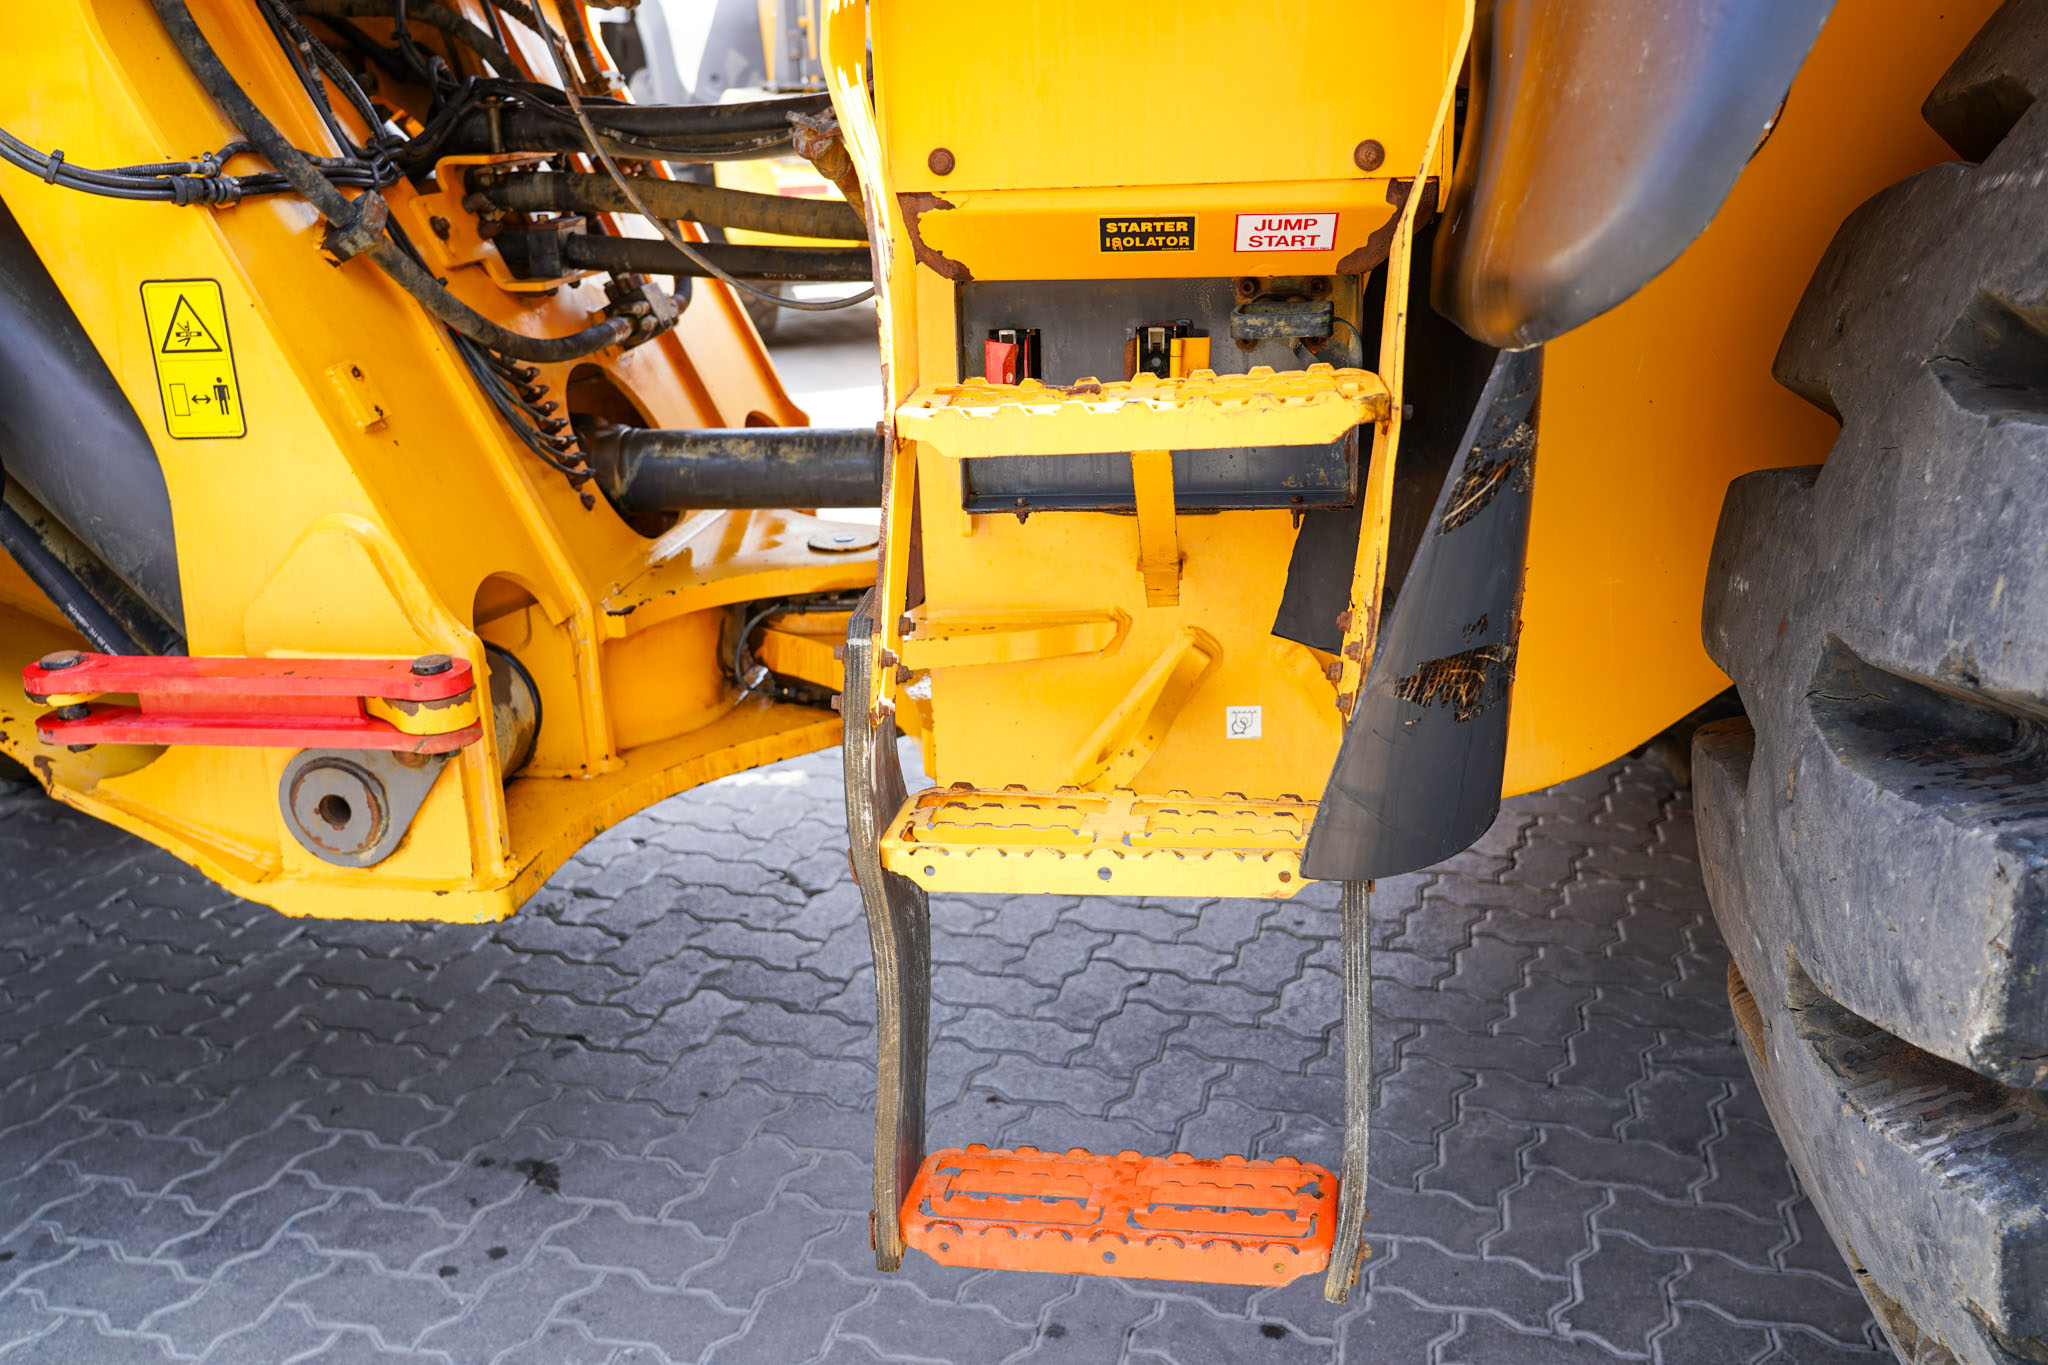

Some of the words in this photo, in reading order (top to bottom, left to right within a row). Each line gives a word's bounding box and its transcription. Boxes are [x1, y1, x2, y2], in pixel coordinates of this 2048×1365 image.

[1105, 221, 1188, 233] STARTER
[1254, 218, 1318, 231] JUMP
[1105, 236, 1190, 248] ISOLATOR
[1248, 234, 1321, 248] START
